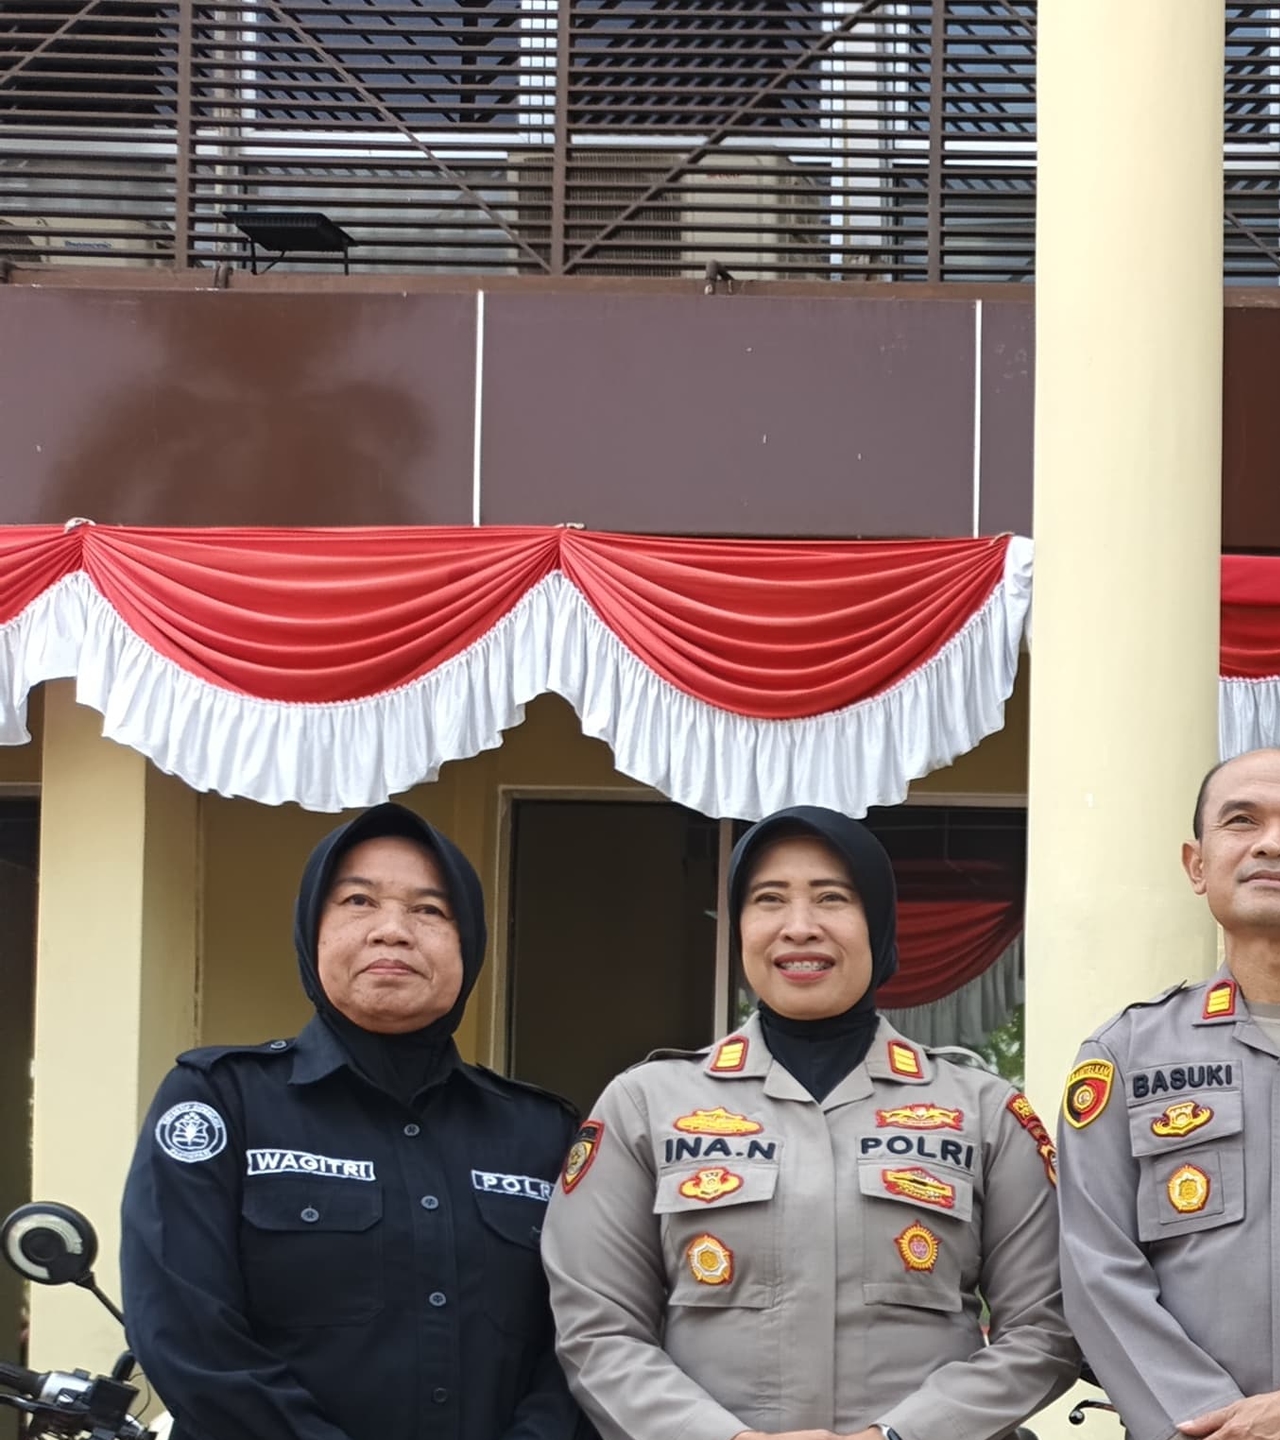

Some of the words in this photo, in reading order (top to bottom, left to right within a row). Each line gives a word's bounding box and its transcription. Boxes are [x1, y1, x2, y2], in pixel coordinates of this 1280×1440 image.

[1132, 1064, 1233, 1098] BASUKI
[256, 1152, 367, 1178] WAGITRI
[861, 1136, 973, 1169] POLRI
[482, 1174, 552, 1200] POLR
